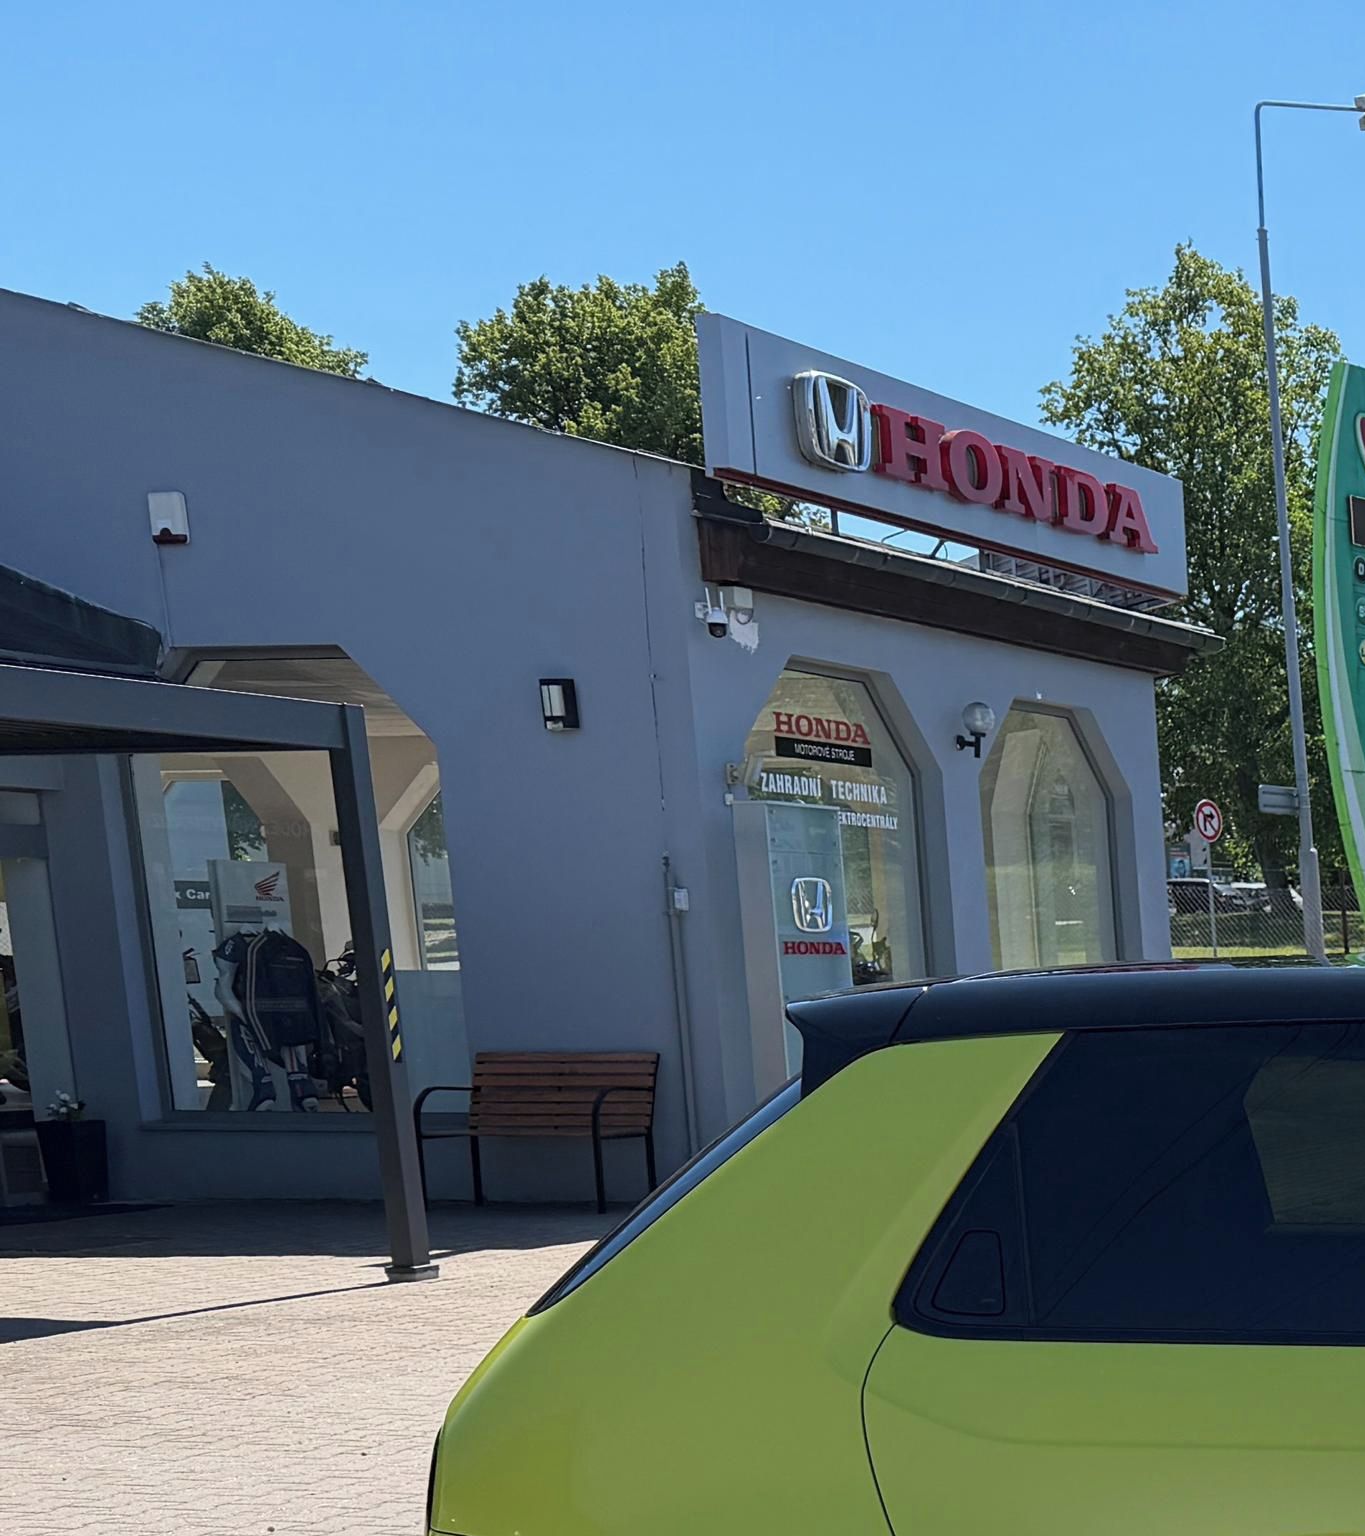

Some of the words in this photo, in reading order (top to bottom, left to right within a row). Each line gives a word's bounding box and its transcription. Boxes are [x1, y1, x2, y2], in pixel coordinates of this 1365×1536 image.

[871, 404, 1158, 553] HONDA
[1358, 563, 1365, 576] D
[773, 712, 871, 745] HONDA
[794, 743, 830, 759] MOTOROVÉ
[831, 747, 856, 761] STROJE
[760, 772, 822, 797] ZAHRADNÍ
[830, 780, 888, 804] TECHNIKA
[783, 941, 847, 955] HONDA
